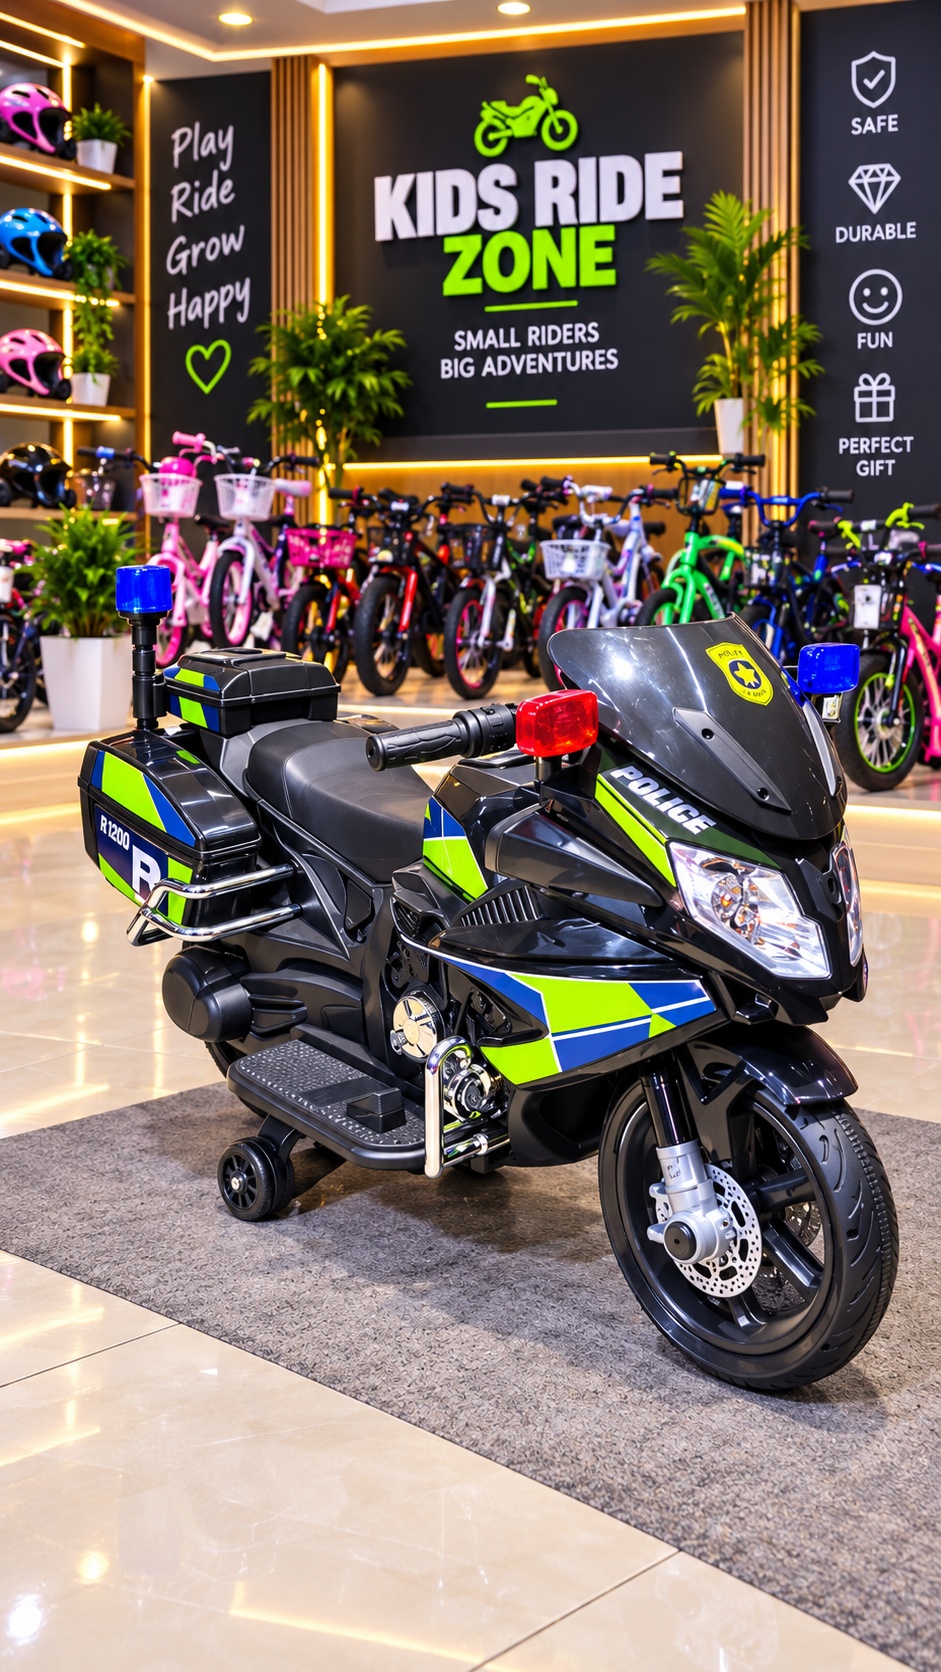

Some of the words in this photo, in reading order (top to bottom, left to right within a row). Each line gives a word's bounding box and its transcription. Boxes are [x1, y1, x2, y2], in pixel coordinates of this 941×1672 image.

[850, 113, 900, 136] SAFE
[171, 122, 235, 172] Play
[171, 171, 235, 223] Ride
[374, 162, 519, 242] KIDS
[534, 151, 685, 228] RIDE
[166, 225, 246, 275] Grow
[835, 221, 918, 244] DURABLE
[442, 224, 617, 297] ZONE
[167, 277, 251, 329] Happy
[454, 326, 521, 351] SMALL
[527, 321, 600, 347] RIDERS
[856, 331, 894, 350] FUN
[440, 357, 476, 379] BIG
[481, 348, 619, 377] ADVENTURES
[838, 436, 914, 455] PERFECT
[855, 459, 897, 477] GIFT
[610, 765, 717, 835] POLICE
